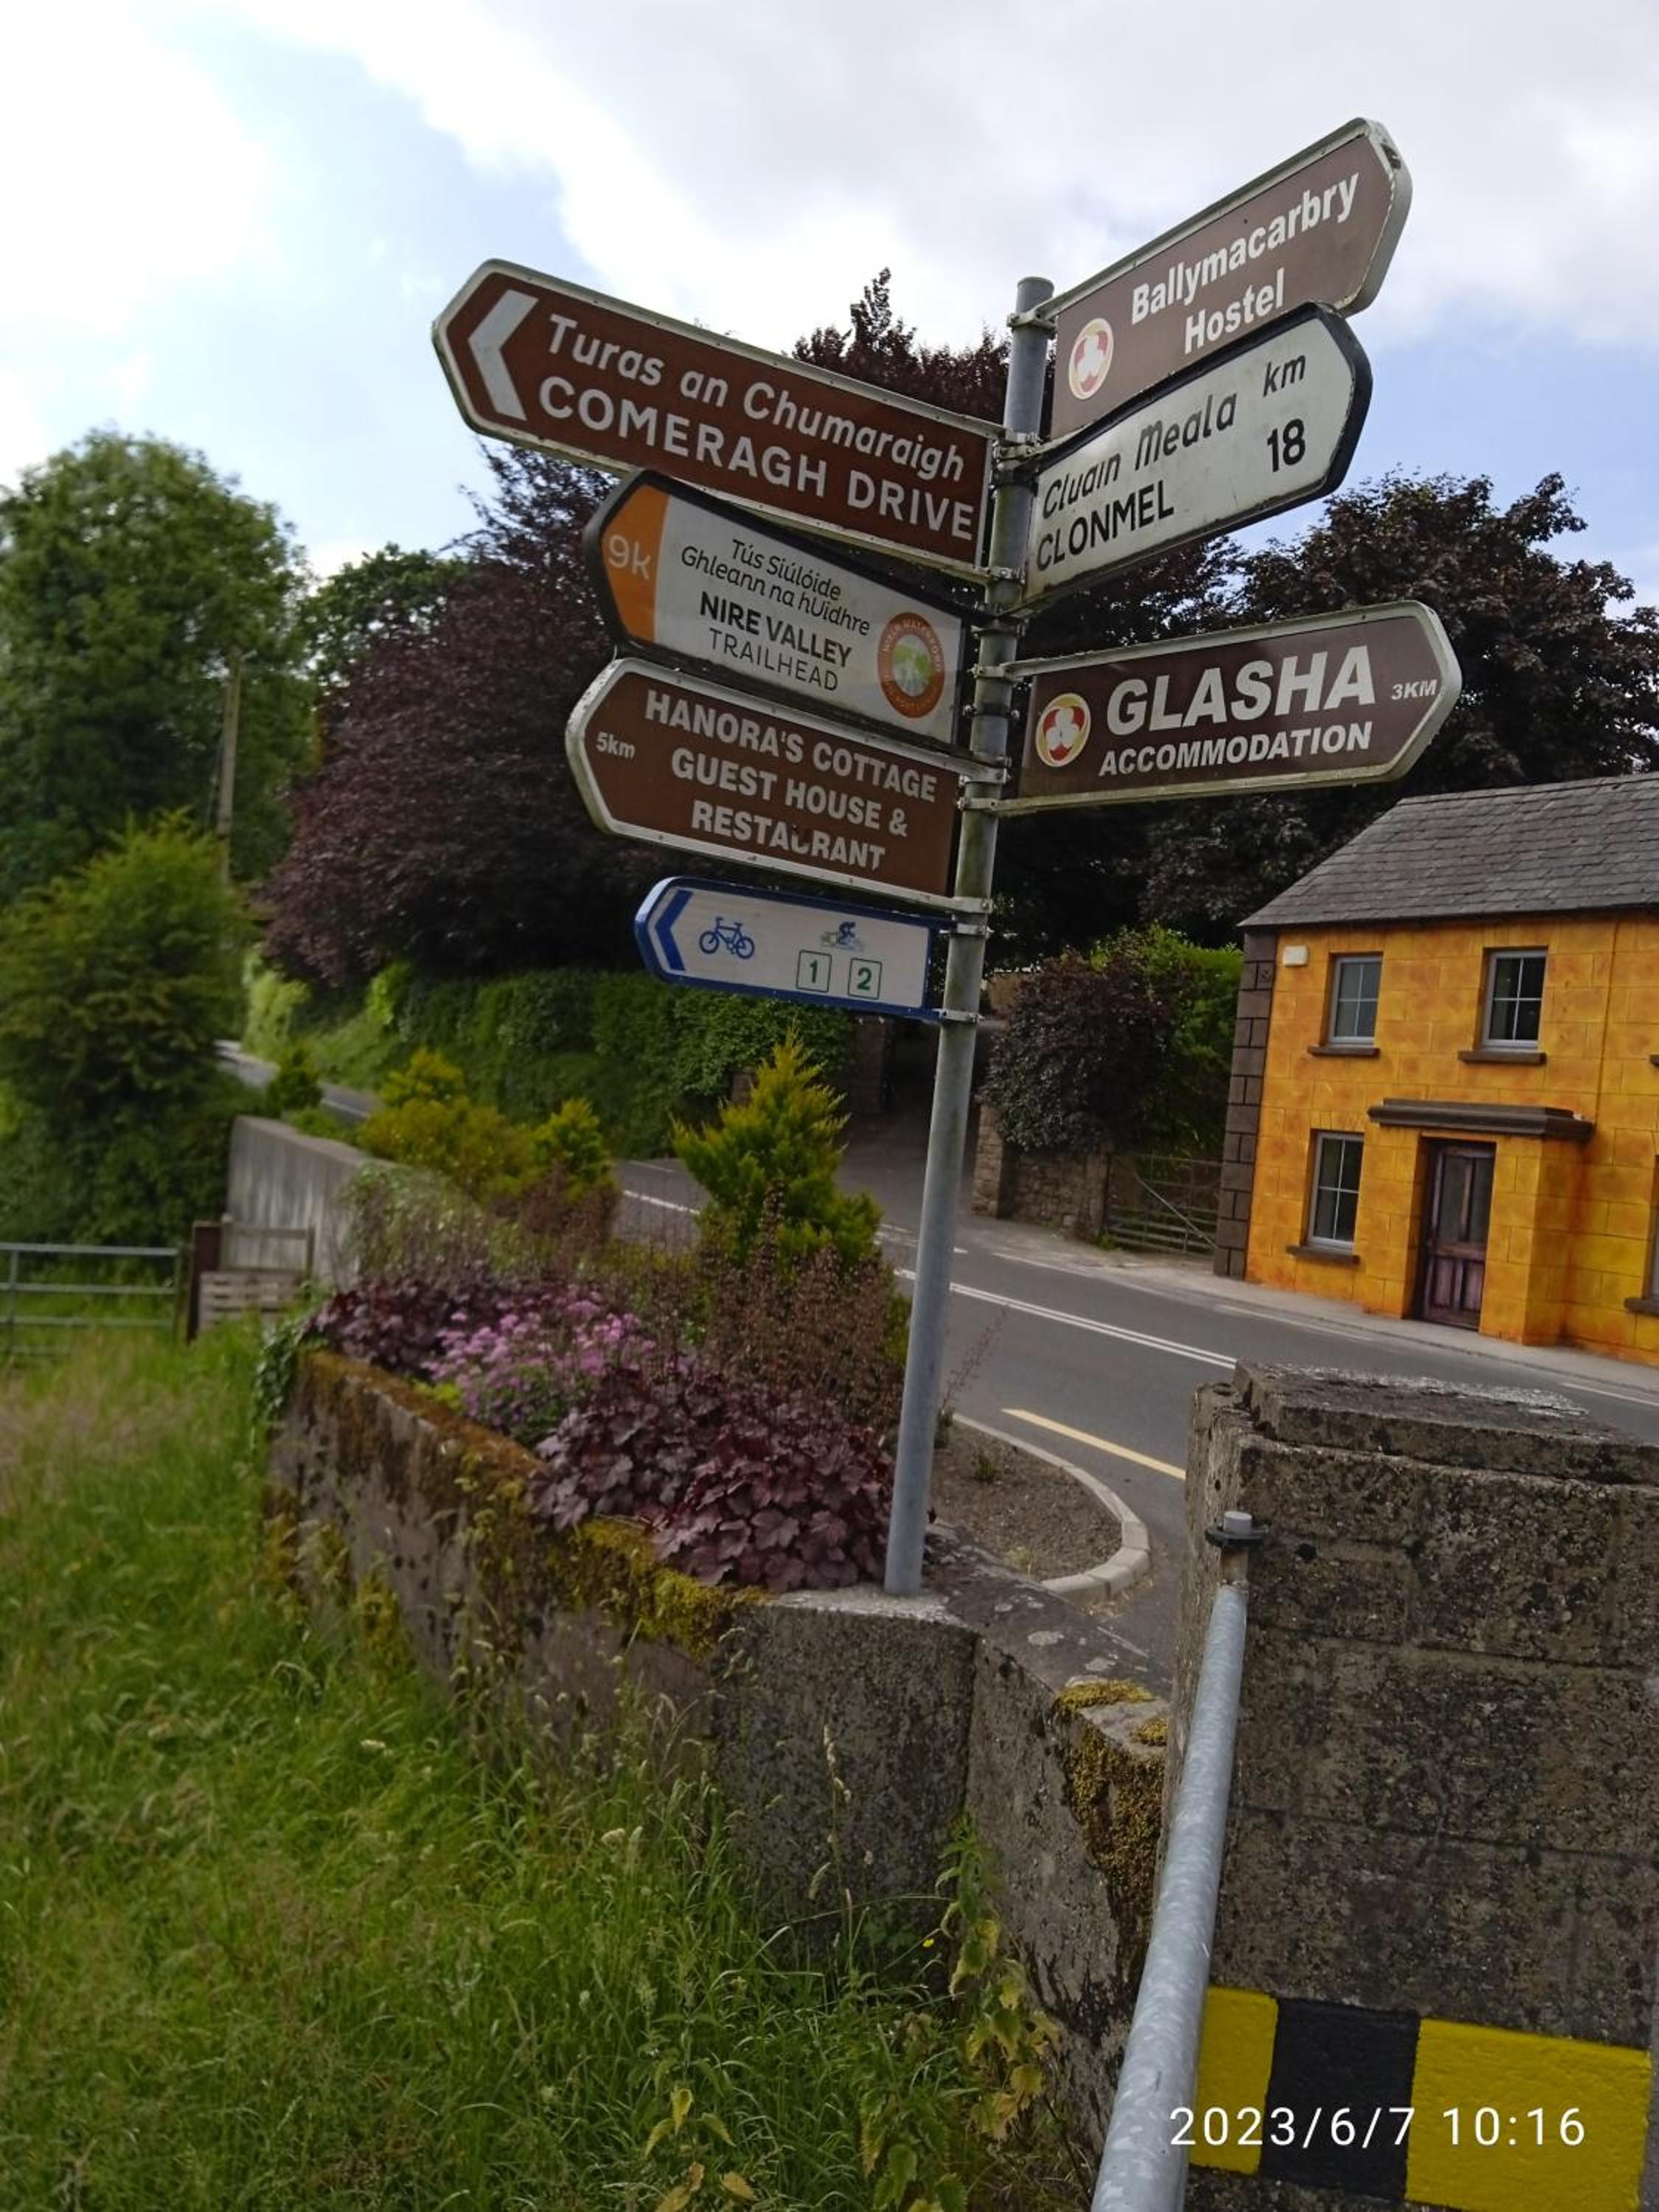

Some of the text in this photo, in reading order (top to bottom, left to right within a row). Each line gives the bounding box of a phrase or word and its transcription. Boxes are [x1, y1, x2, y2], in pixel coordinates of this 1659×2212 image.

[1131, 173, 1360, 326] Ballymacarbry
[1184, 268, 1286, 355] Hostel
[547, 313, 966, 483] Turas an Chumaraigh
[1262, 355, 1307, 397] km
[538, 377, 975, 542] COMERAGH DRIVE
[1042, 392, 1239, 521] Cluain Meala
[1266, 418, 1307, 473] 18
[608, 534, 651, 581] 9k
[1035, 479, 1175, 571] CLONMEL
[681, 546, 872, 636] Ghleann na hUidhre
[731, 538, 842, 601] Tús Siúlóide
[700, 591, 762, 636] NIRE
[765, 615, 852, 668] VALLEY
[709, 627, 839, 692] TRAILHEAD
[1106, 644, 1377, 737] GLASHA
[1391, 679, 1438, 701] 3KM
[595, 731, 636, 761] 5km
[644, 689, 804, 764] HANORA'S
[813, 742, 938, 803] COTTAGE
[1098, 720, 1374, 777] ACCOMMODATION
[670, 747, 908, 838] GUEST HOUSE &
[809, 959, 819, 984] 1
[856, 967, 872, 991] 2
